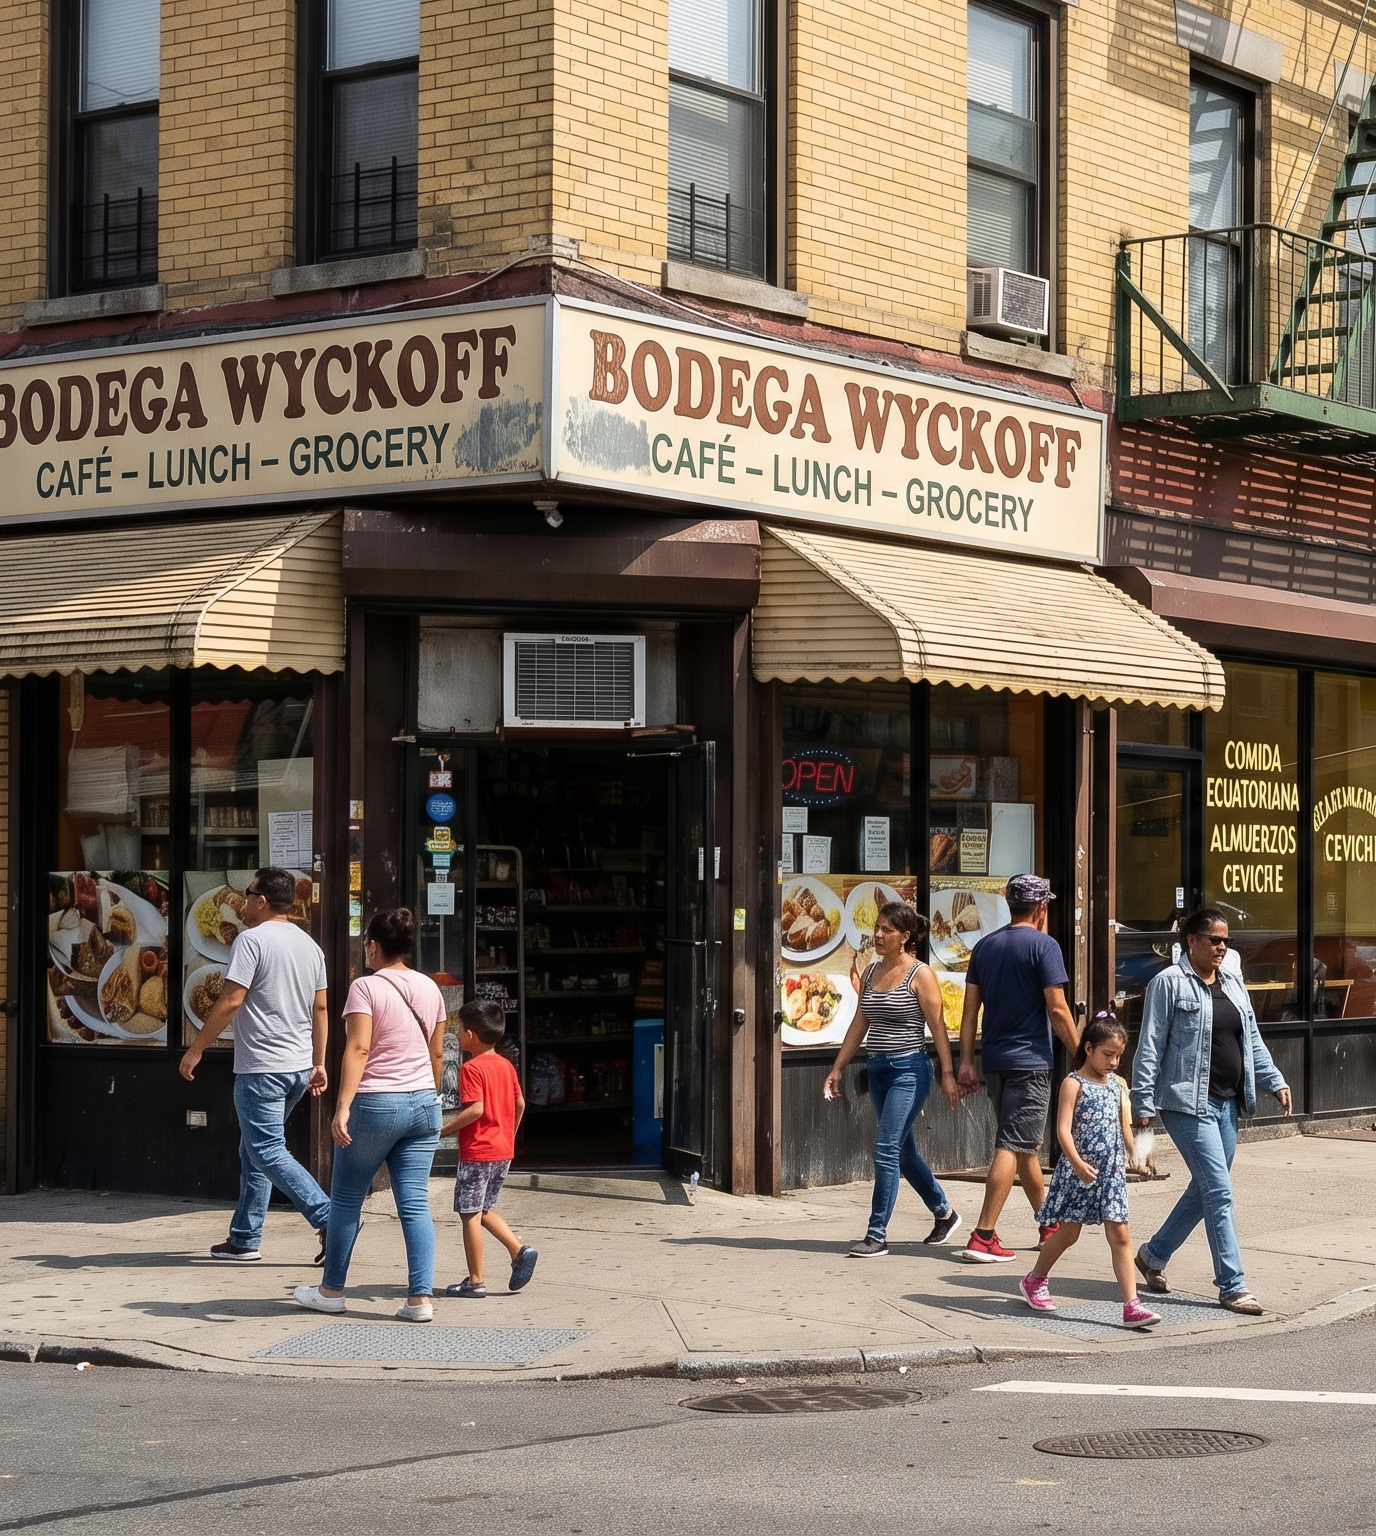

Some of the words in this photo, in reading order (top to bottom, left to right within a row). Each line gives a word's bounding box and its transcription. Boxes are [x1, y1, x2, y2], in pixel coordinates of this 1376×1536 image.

[221, 324, 517, 426] WYCKOFF
[589, 329, 831, 444] BODEGA
[845, 382, 1082, 489] WYCKOFF
[36, 446, 112, 499] CAFÉ
[148, 442, 251, 489] LUNCH
[289, 422, 451, 477] GROCERY
[651, 433, 737, 486] CAFÉ
[773, 453, 872, 507] LUNCH
[905, 477, 1035, 533] GROCERY
[782, 758, 855, 794] OPEN
[1224, 740, 1282, 773] COMIDA
[1206, 777, 1300, 812] ECUATORIANA
[1210, 824, 1297, 855] ALMUERZOS
